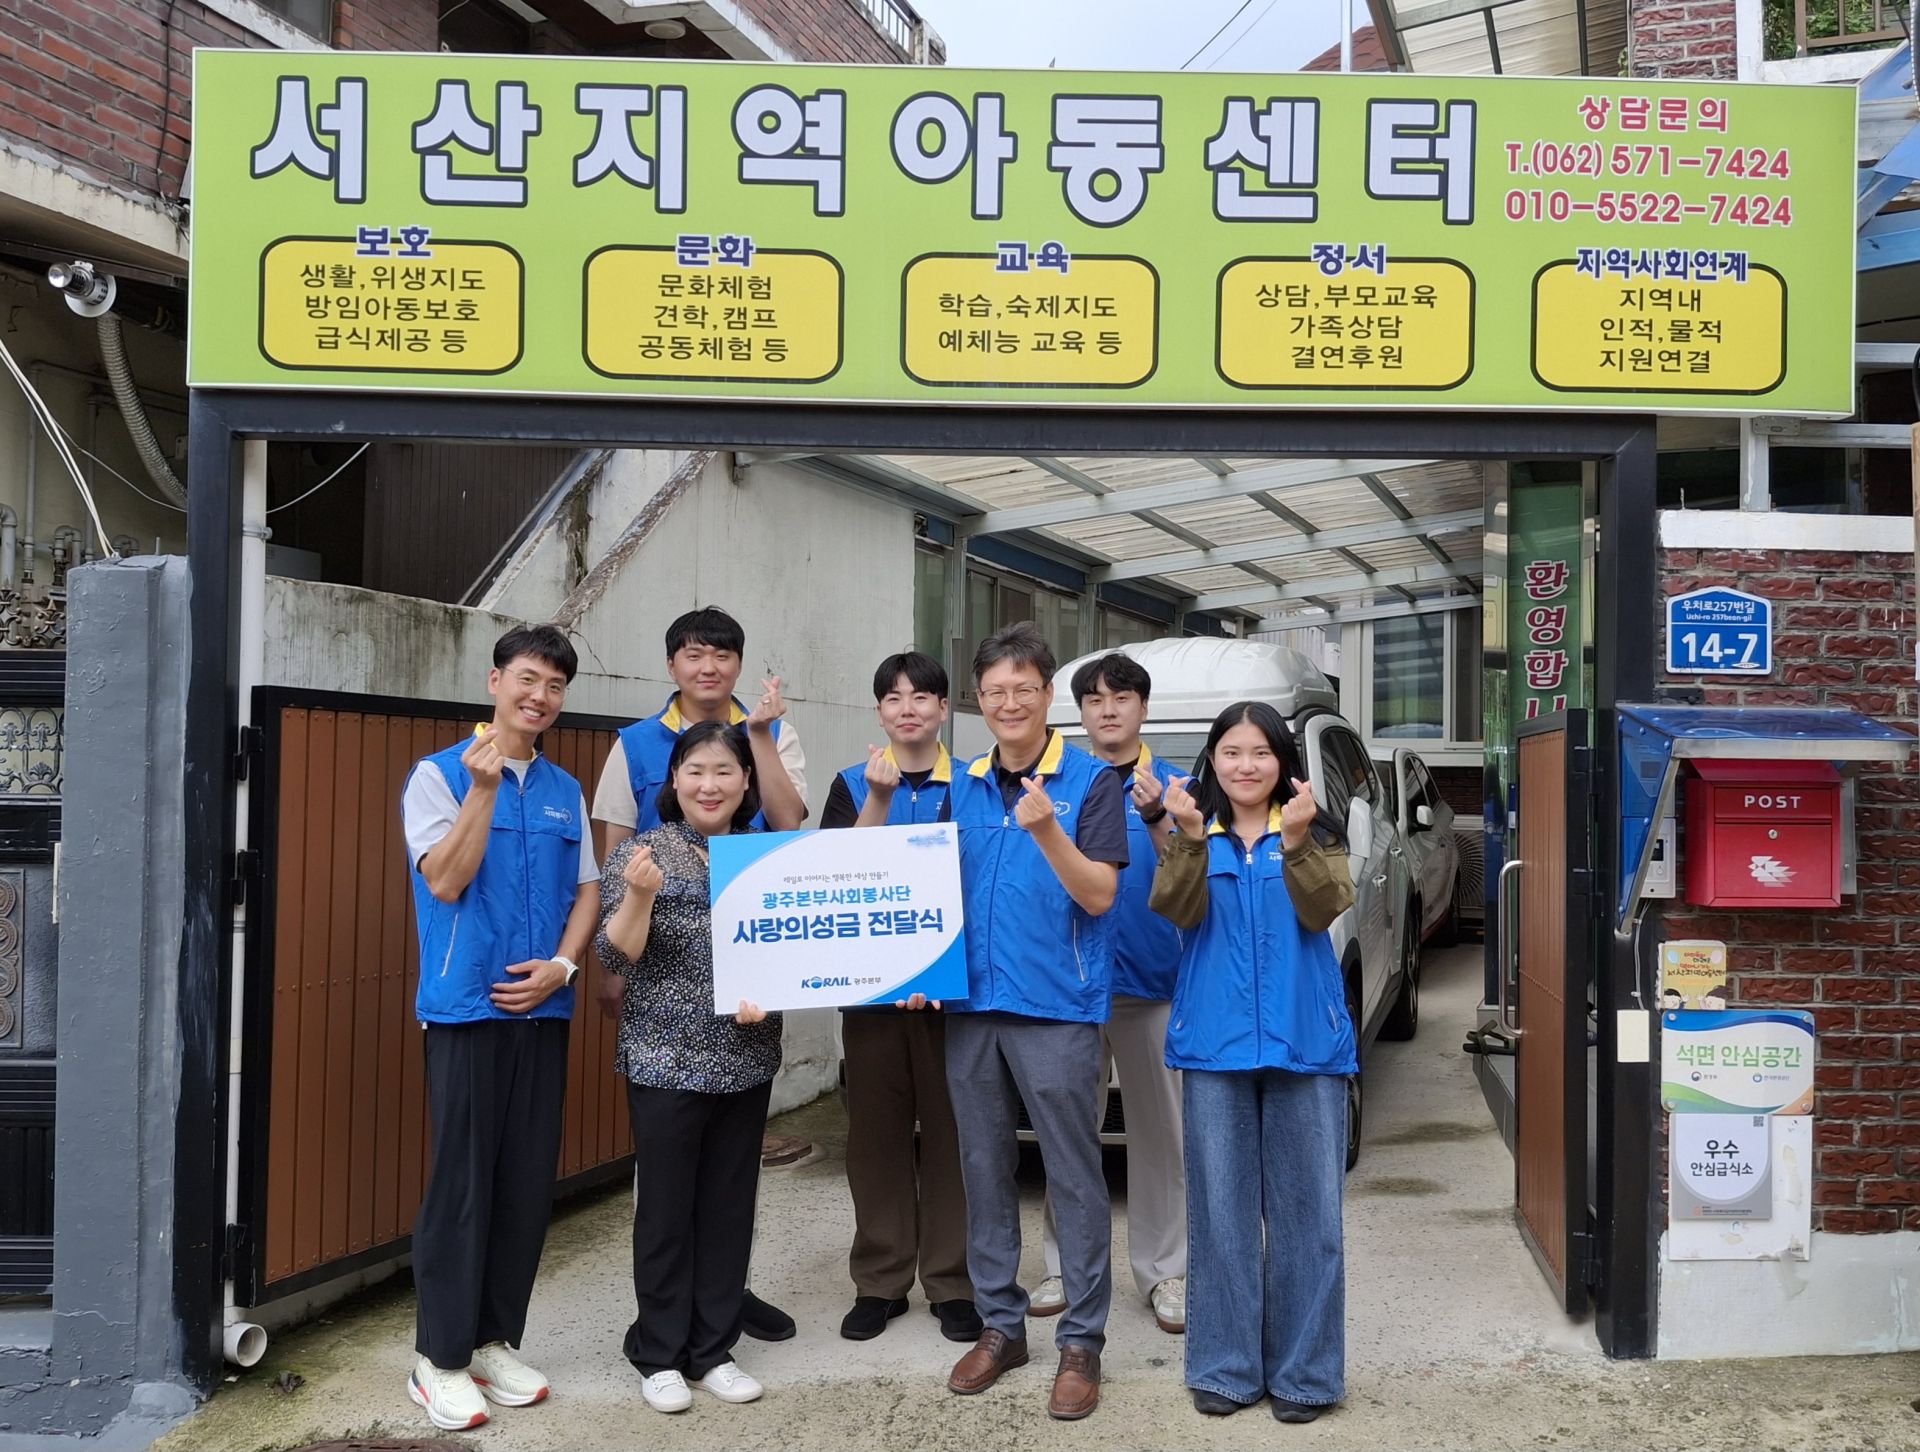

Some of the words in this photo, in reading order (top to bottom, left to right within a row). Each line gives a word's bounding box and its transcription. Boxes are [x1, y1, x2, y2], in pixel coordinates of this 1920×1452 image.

[1578, 95, 1728, 133] 상담문의
[250, 75, 1477, 227] 서산지역아동센터
[1505, 190, 1792, 226] 010-5522-7424
[356, 224, 432, 259] 보호
[675, 233, 756, 268] 문화
[995, 241, 1070, 275] 교육
[1312, 243, 1386, 276] 정서
[1576, 248, 1748, 282] 지역사회연계
[657, 275, 773, 301] 문화체험
[1619, 288, 1703, 313] 지역내
[305, 296, 481, 322] 방임아동보호
[315, 326, 432, 353] 급식제공
[442, 328, 468, 353] 등
[1290, 314, 1403, 340] 가족상담
[638, 335, 754, 362] 공동체험
[762, 338, 789, 363] 등
[938, 329, 1021, 355] 예체능
[1031, 330, 1087, 356] 교육
[1096, 331, 1123, 356] 등
[1291, 345, 1403, 370] 결연후원
[1599, 348, 1711, 374] 지원연결
[1681, 600, 1755, 614] 우치로257번길
[1681, 632, 1758, 663] 14-7
[1744, 795, 1802, 809] POST
[762, 885, 911, 909] 광주본부사회봉사단
[733, 912, 860, 944] 사랑의성금
[868, 908, 943, 936] 전달식
[801, 976, 852, 989] KORAIL
[1676, 1044, 1716, 1067] 석면
[1721, 1045, 1802, 1069] 안심공간
[1704, 1139, 1740, 1159] 우수
[1690, 1162, 1754, 1178] 안심급식소
